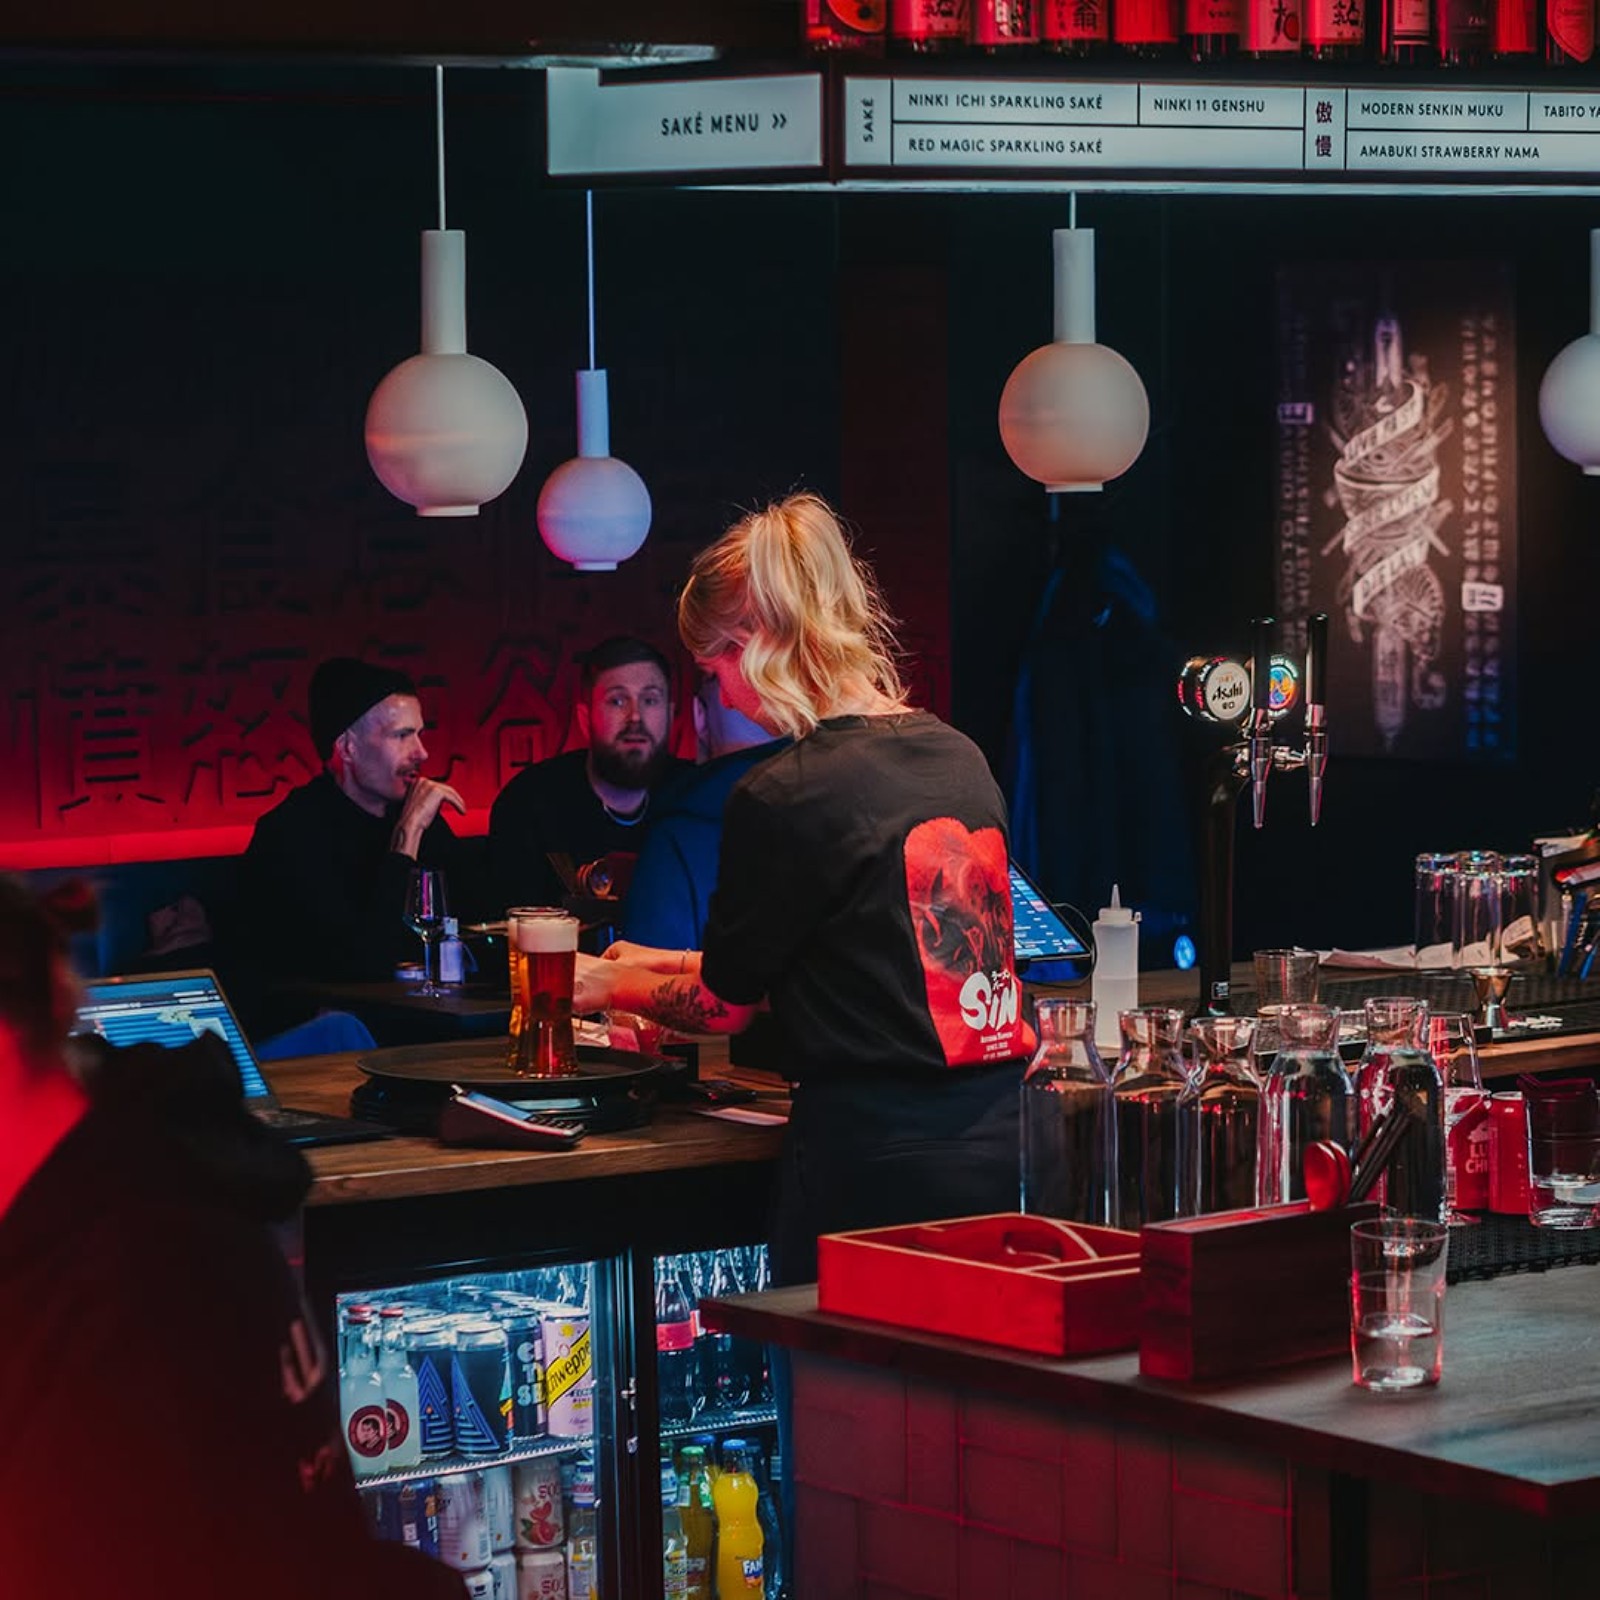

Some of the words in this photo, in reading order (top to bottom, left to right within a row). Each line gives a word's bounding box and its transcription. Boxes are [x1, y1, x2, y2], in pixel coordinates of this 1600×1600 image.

[908, 93, 949, 107] NINKI
[955, 93, 986, 108] ICHI
[989, 93, 1066, 110] SPARKLING
[1069, 93, 1103, 111] SAKÉ
[1153, 94, 1193, 112] NINKI
[1195, 98, 1207, 112] 11
[1210, 95, 1266, 114] GENSHU
[1360, 101, 1415, 116] MODERN
[1417, 102, 1464, 117] SENKIN
[1467, 100, 1504, 118] MUKU
[1542, 104, 1586, 118] TABITO
[653, 112, 703, 136] SAKÉ
[710, 112, 759, 133] MENU
[860, 97, 875, 143] SAKÉ
[908, 137, 936, 153] RED
[939, 138, 986, 153] MAGIC
[989, 138, 1066, 154] SPARKLING
[1069, 137, 1103, 155] SAKÉ
[1359, 144, 1418, 159] AMABUKI
[1420, 145, 1501, 159] STRAWBERRY
[1504, 145, 1541, 160] NAMA
[1211, 680, 1244, 701] Asahi
